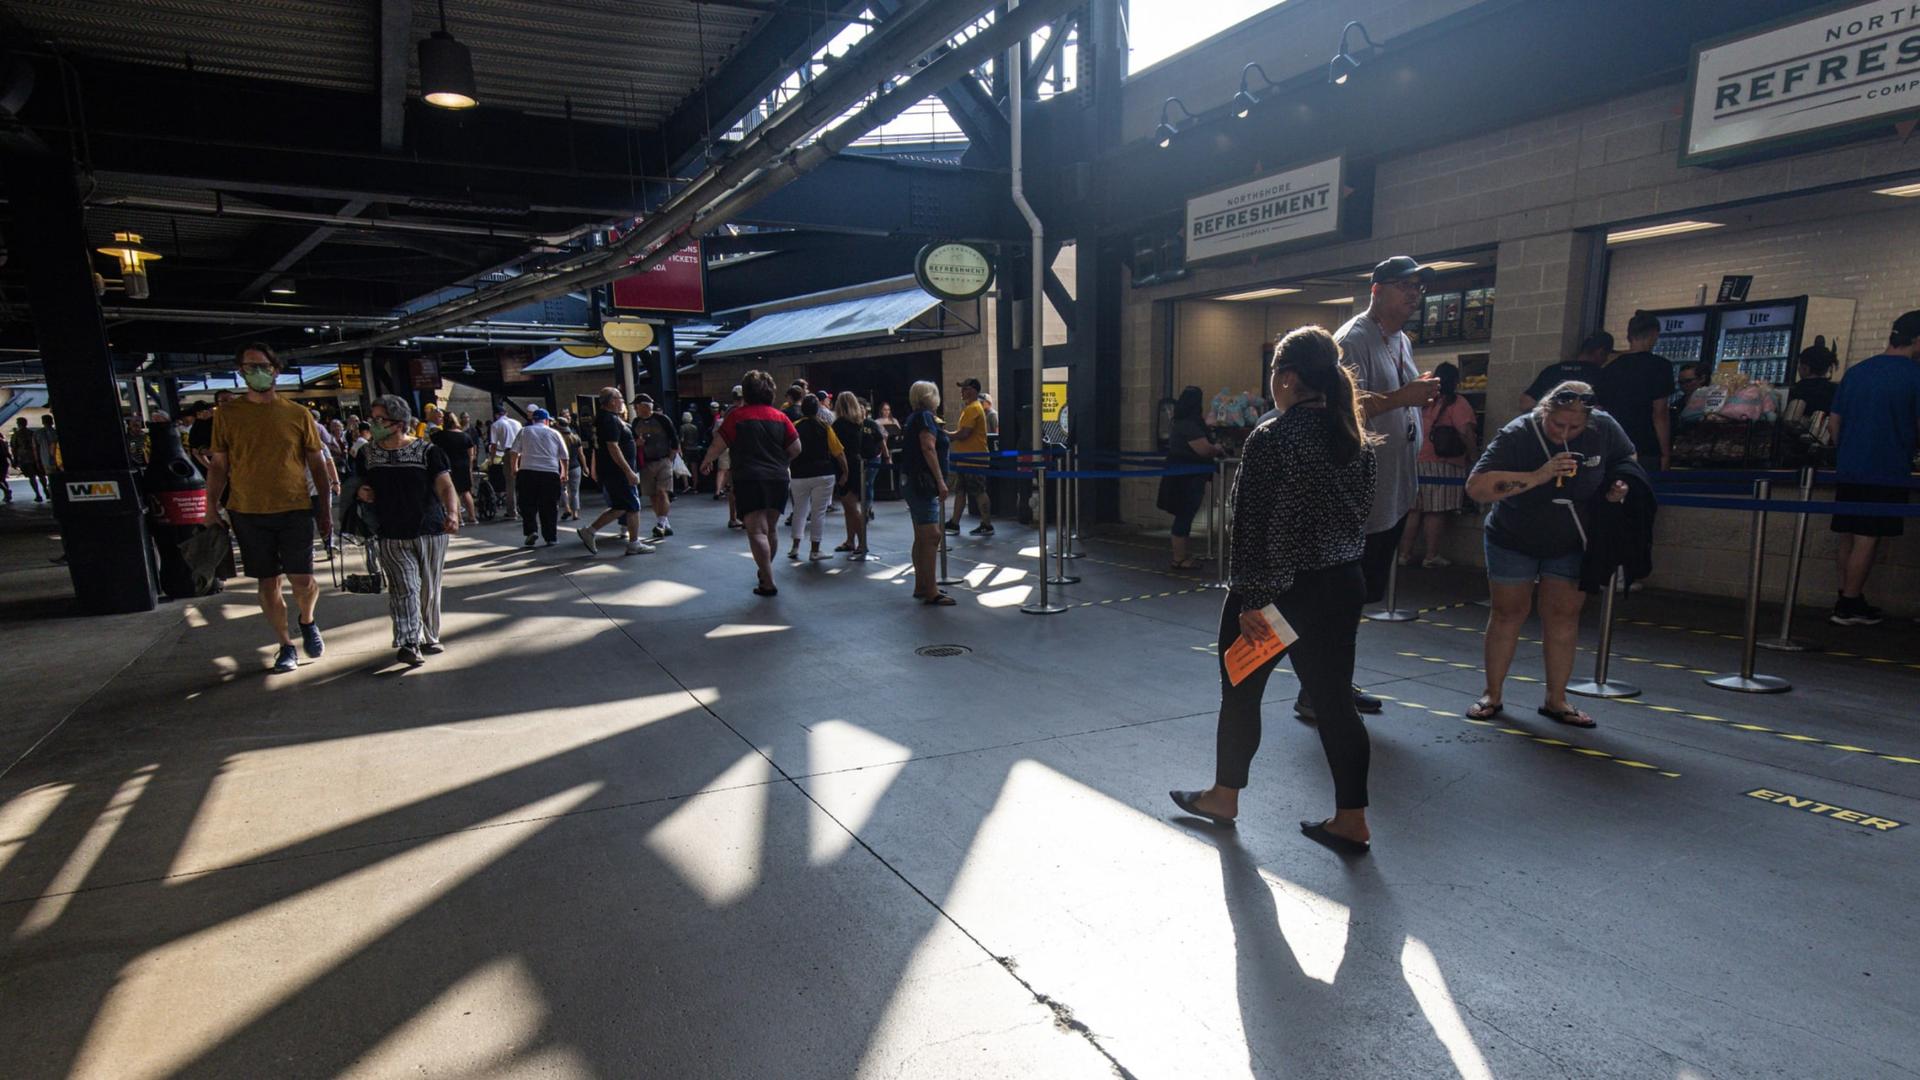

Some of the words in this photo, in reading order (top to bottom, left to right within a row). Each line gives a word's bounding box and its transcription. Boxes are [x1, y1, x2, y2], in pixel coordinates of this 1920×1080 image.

[1867, 80, 1920, 99] COMP
[1227, 183, 1291, 206] NORTHSHORE
[1193, 188, 1329, 236] REFRESHMENT
[1665, 319, 1684, 331] Lite
[1749, 311, 1770, 325] Lite
[69, 484, 113, 496] WM
[1746, 788, 1901, 830] ENTER
